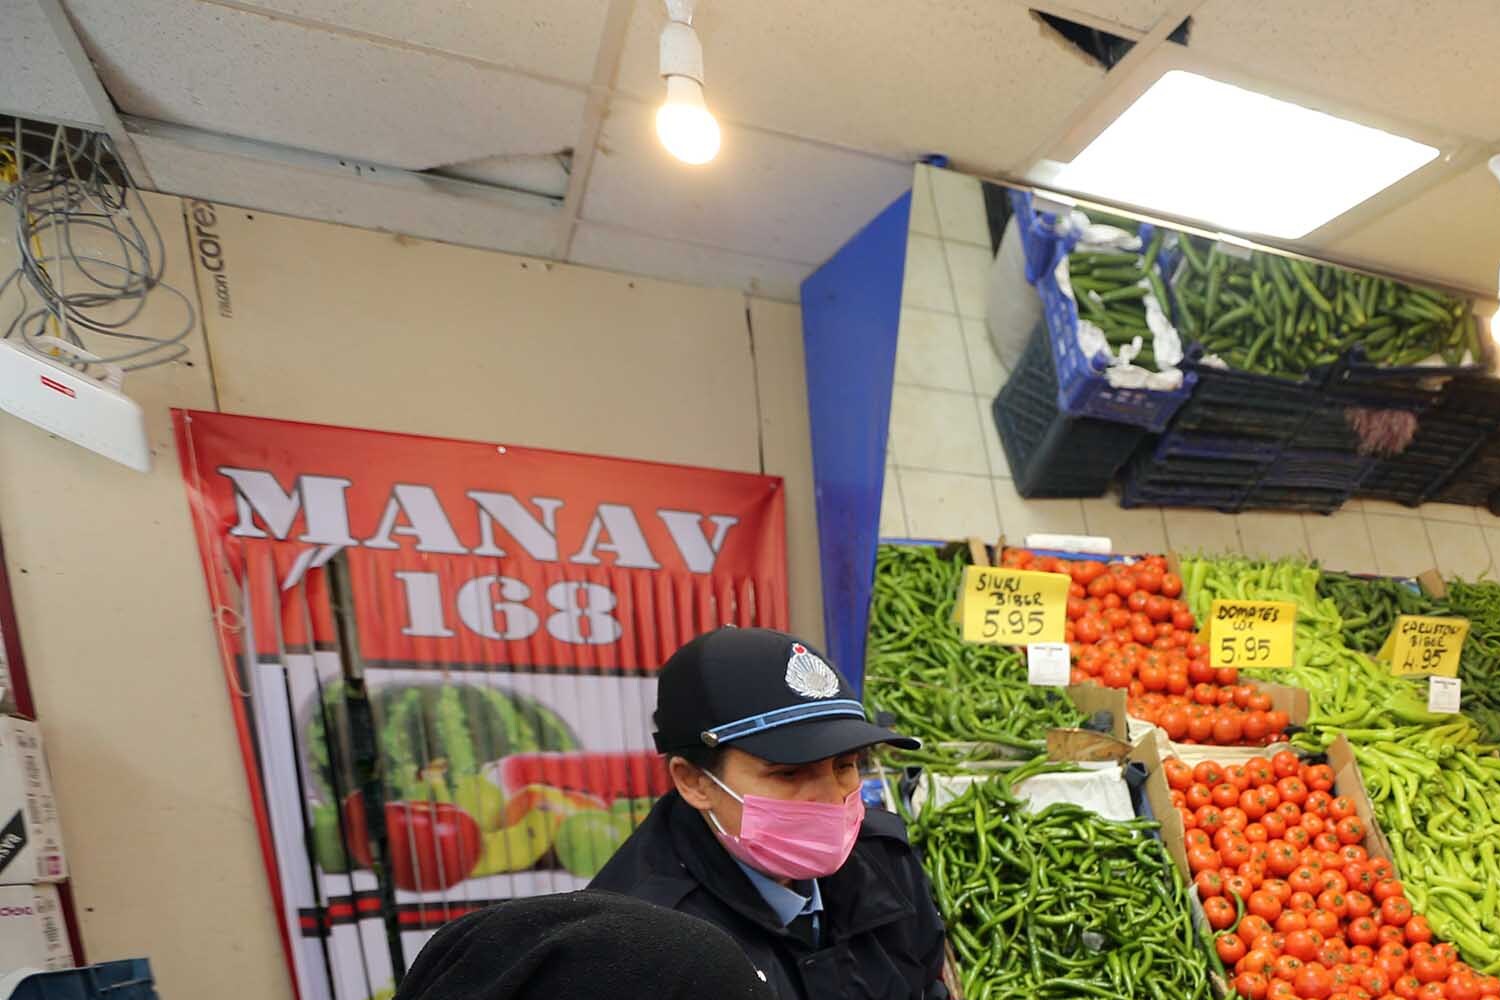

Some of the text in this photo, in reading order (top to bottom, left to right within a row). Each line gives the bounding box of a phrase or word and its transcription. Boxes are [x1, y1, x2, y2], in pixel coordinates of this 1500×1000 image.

[218, 466, 739, 575] MANAV
[395, 571, 623, 646] 168
[1217, 605, 1280, 622] DOMATES
[982, 609, 1045, 638] 5.95
[1221, 636, 1271, 664] 5.95
